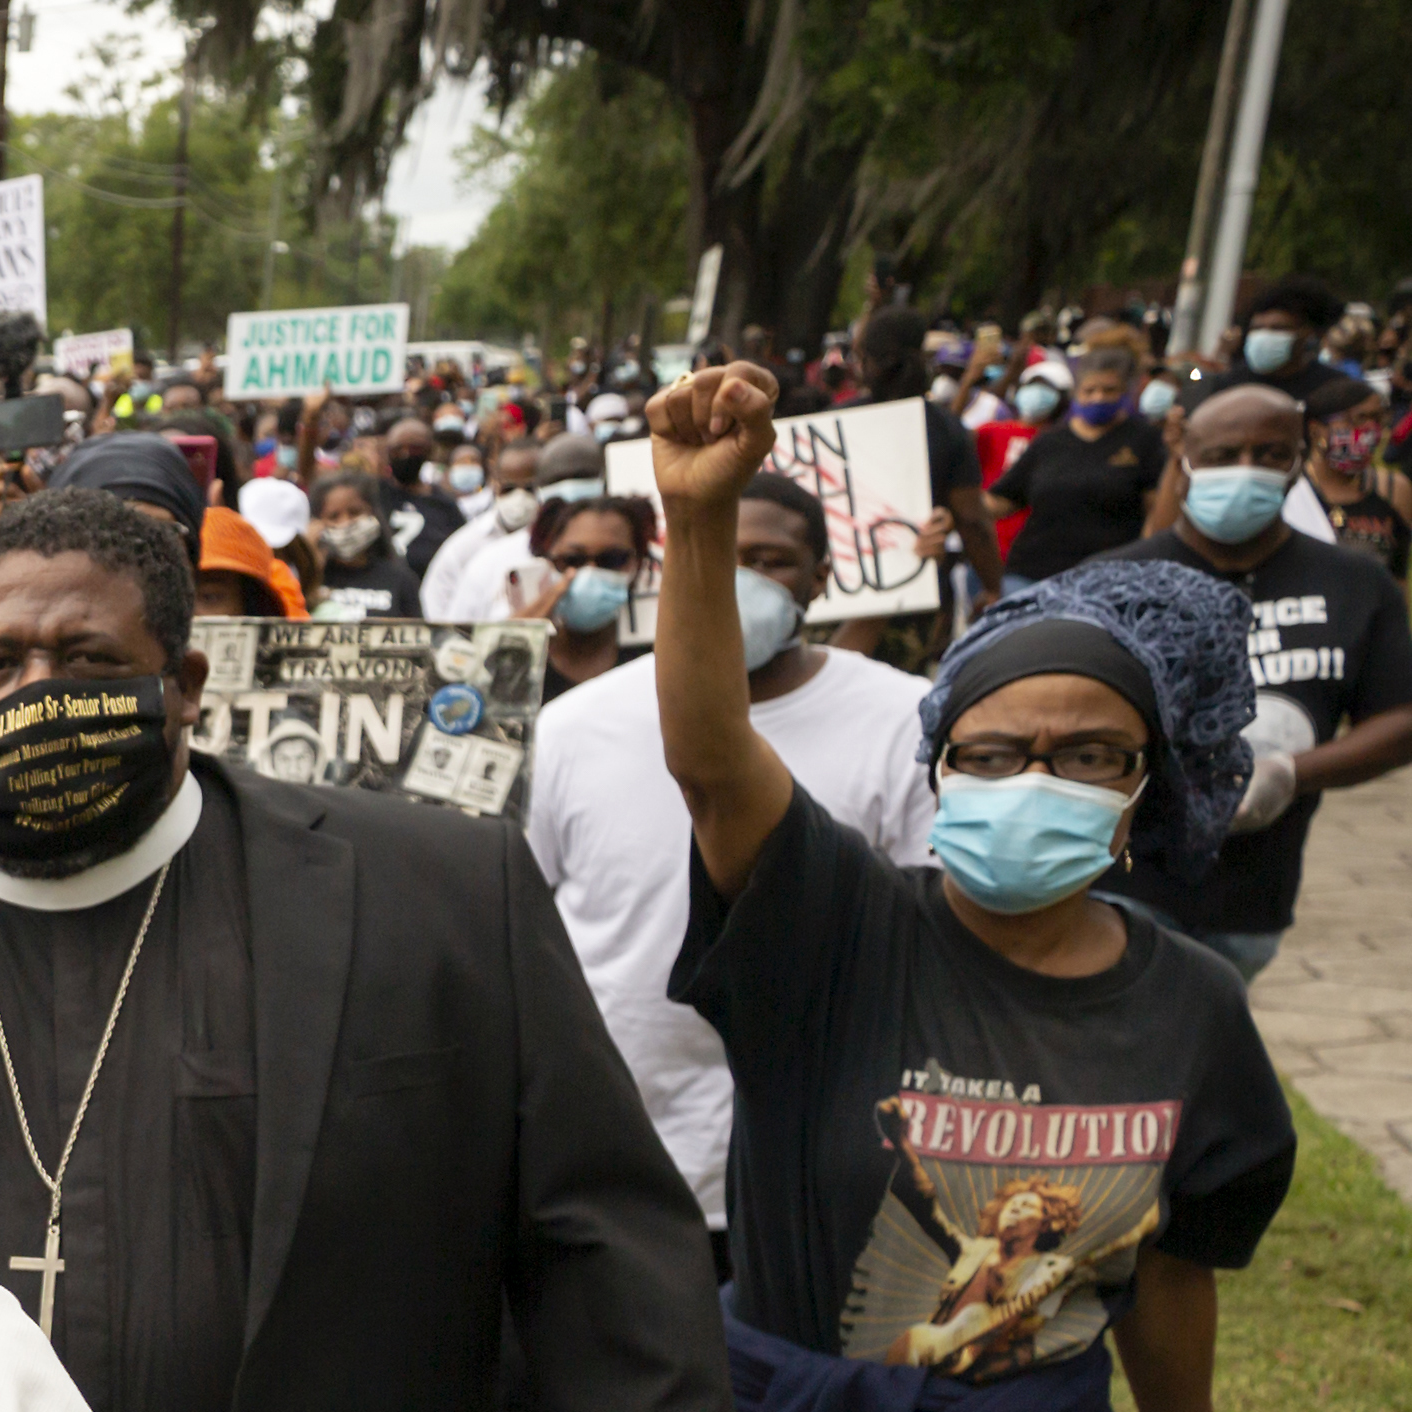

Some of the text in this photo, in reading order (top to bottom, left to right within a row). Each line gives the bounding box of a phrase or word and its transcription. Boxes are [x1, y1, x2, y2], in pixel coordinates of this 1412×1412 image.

[242, 311, 397, 348] JUSTICE FOR
[242, 348, 393, 390] AHMAUD
[275, 625, 426, 644] WE ARE ALL
[284, 658, 415, 679] TRAYVON
[64, 691, 101, 718] Senior
[101, 692, 139, 717] Pastor
[901, 1068, 930, 1090] IT
[1022, 1082, 1042, 1103] A
